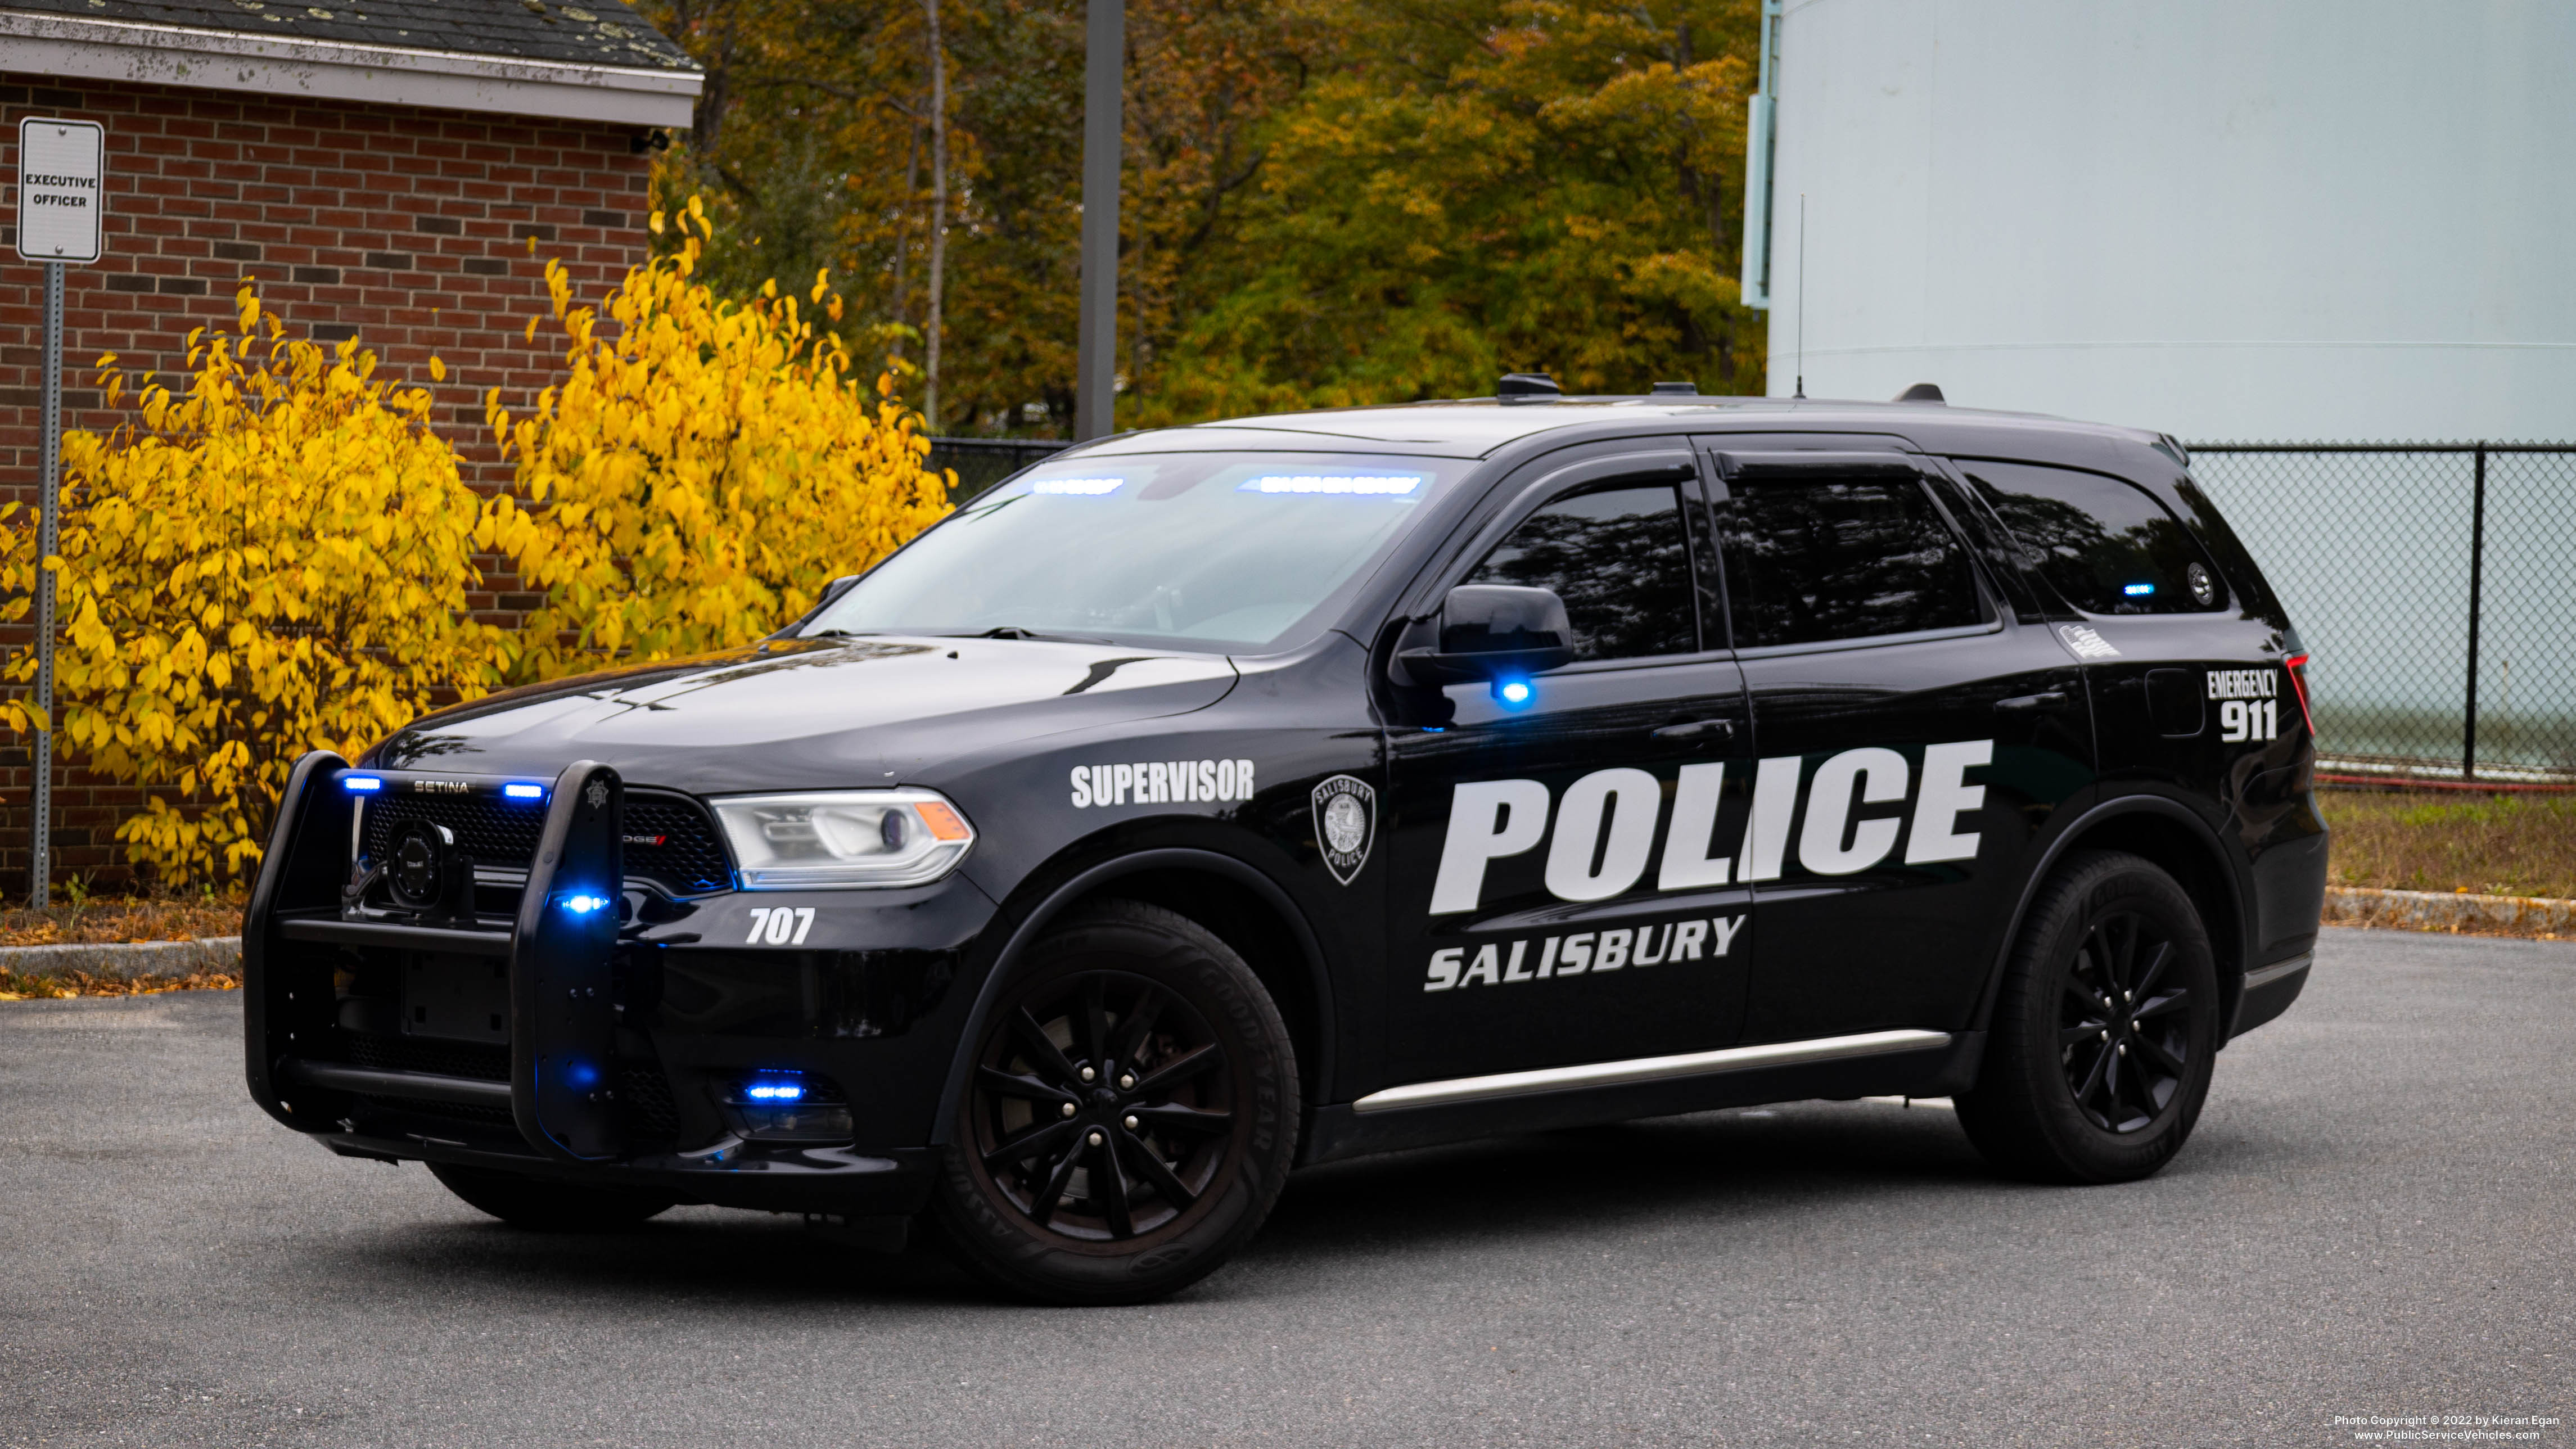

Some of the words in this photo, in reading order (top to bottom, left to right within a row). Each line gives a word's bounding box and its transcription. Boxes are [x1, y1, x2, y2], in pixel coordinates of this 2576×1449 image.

[26, 174, 96, 188] EXECUTIVE
[33, 194, 87, 207] OFFICER
[2207, 669, 2277, 699] EMERGENCY
[2221, 699, 2277, 743] 911
[414, 780, 469, 794] SETINA
[1071, 759, 1255, 809] SUPERVISOR
[1315, 779, 1371, 805] SALISBURY
[1429, 739, 1994, 915] POLICE
[1328, 847, 1364, 868] POLICE
[745, 906, 815, 945] 707
[1424, 914, 1746, 992] SALISBURY
